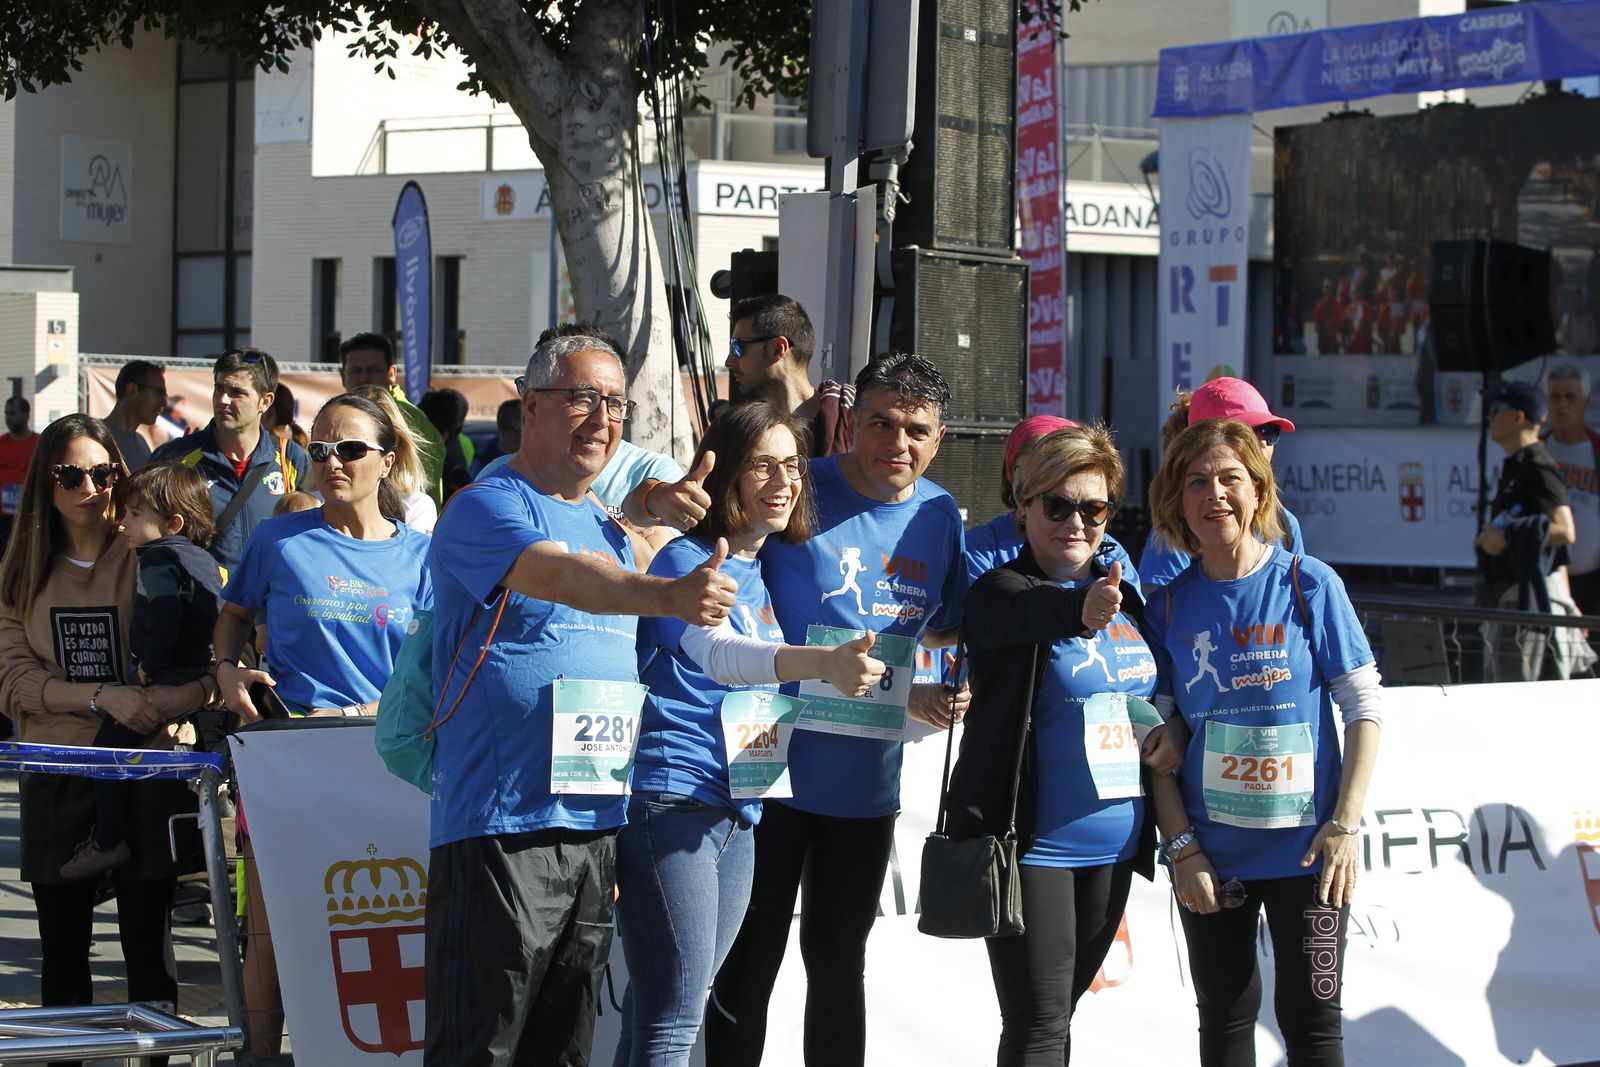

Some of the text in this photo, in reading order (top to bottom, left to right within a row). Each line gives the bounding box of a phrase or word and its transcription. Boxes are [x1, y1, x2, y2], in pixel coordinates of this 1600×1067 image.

[1459, 12, 1524, 32] CARRERA
[1323, 48, 1340, 64] LA
[1343, 38, 1424, 61] IGUALDAD
[1321, 63, 1392, 85] NUESTRA
[87, 202, 127, 227] mujer
[1169, 225, 1246, 246] GRUPO
[1282, 457, 1387, 492] ALMERÍA
[881, 554, 925, 582] VIII
[876, 580, 927, 598] CARRERA
[294, 594, 368, 611] Corremos por
[307, 608, 372, 624] la igualdad
[64, 623, 105, 635] LA VIDA
[1232, 623, 1285, 648] VIII
[65, 638, 109, 650] ES MEJOR
[71, 651, 107, 664] CUANDO
[1230, 650, 1288, 662] CARRERA
[1231, 662, 1251, 671] DE
[1241, 704, 1275, 712] NUESTRA
[574, 714, 633, 743] 2281
[737, 724, 779, 749] 2264
[581, 743, 603, 751] JOSE
[1221, 755, 1293, 782] 2261
